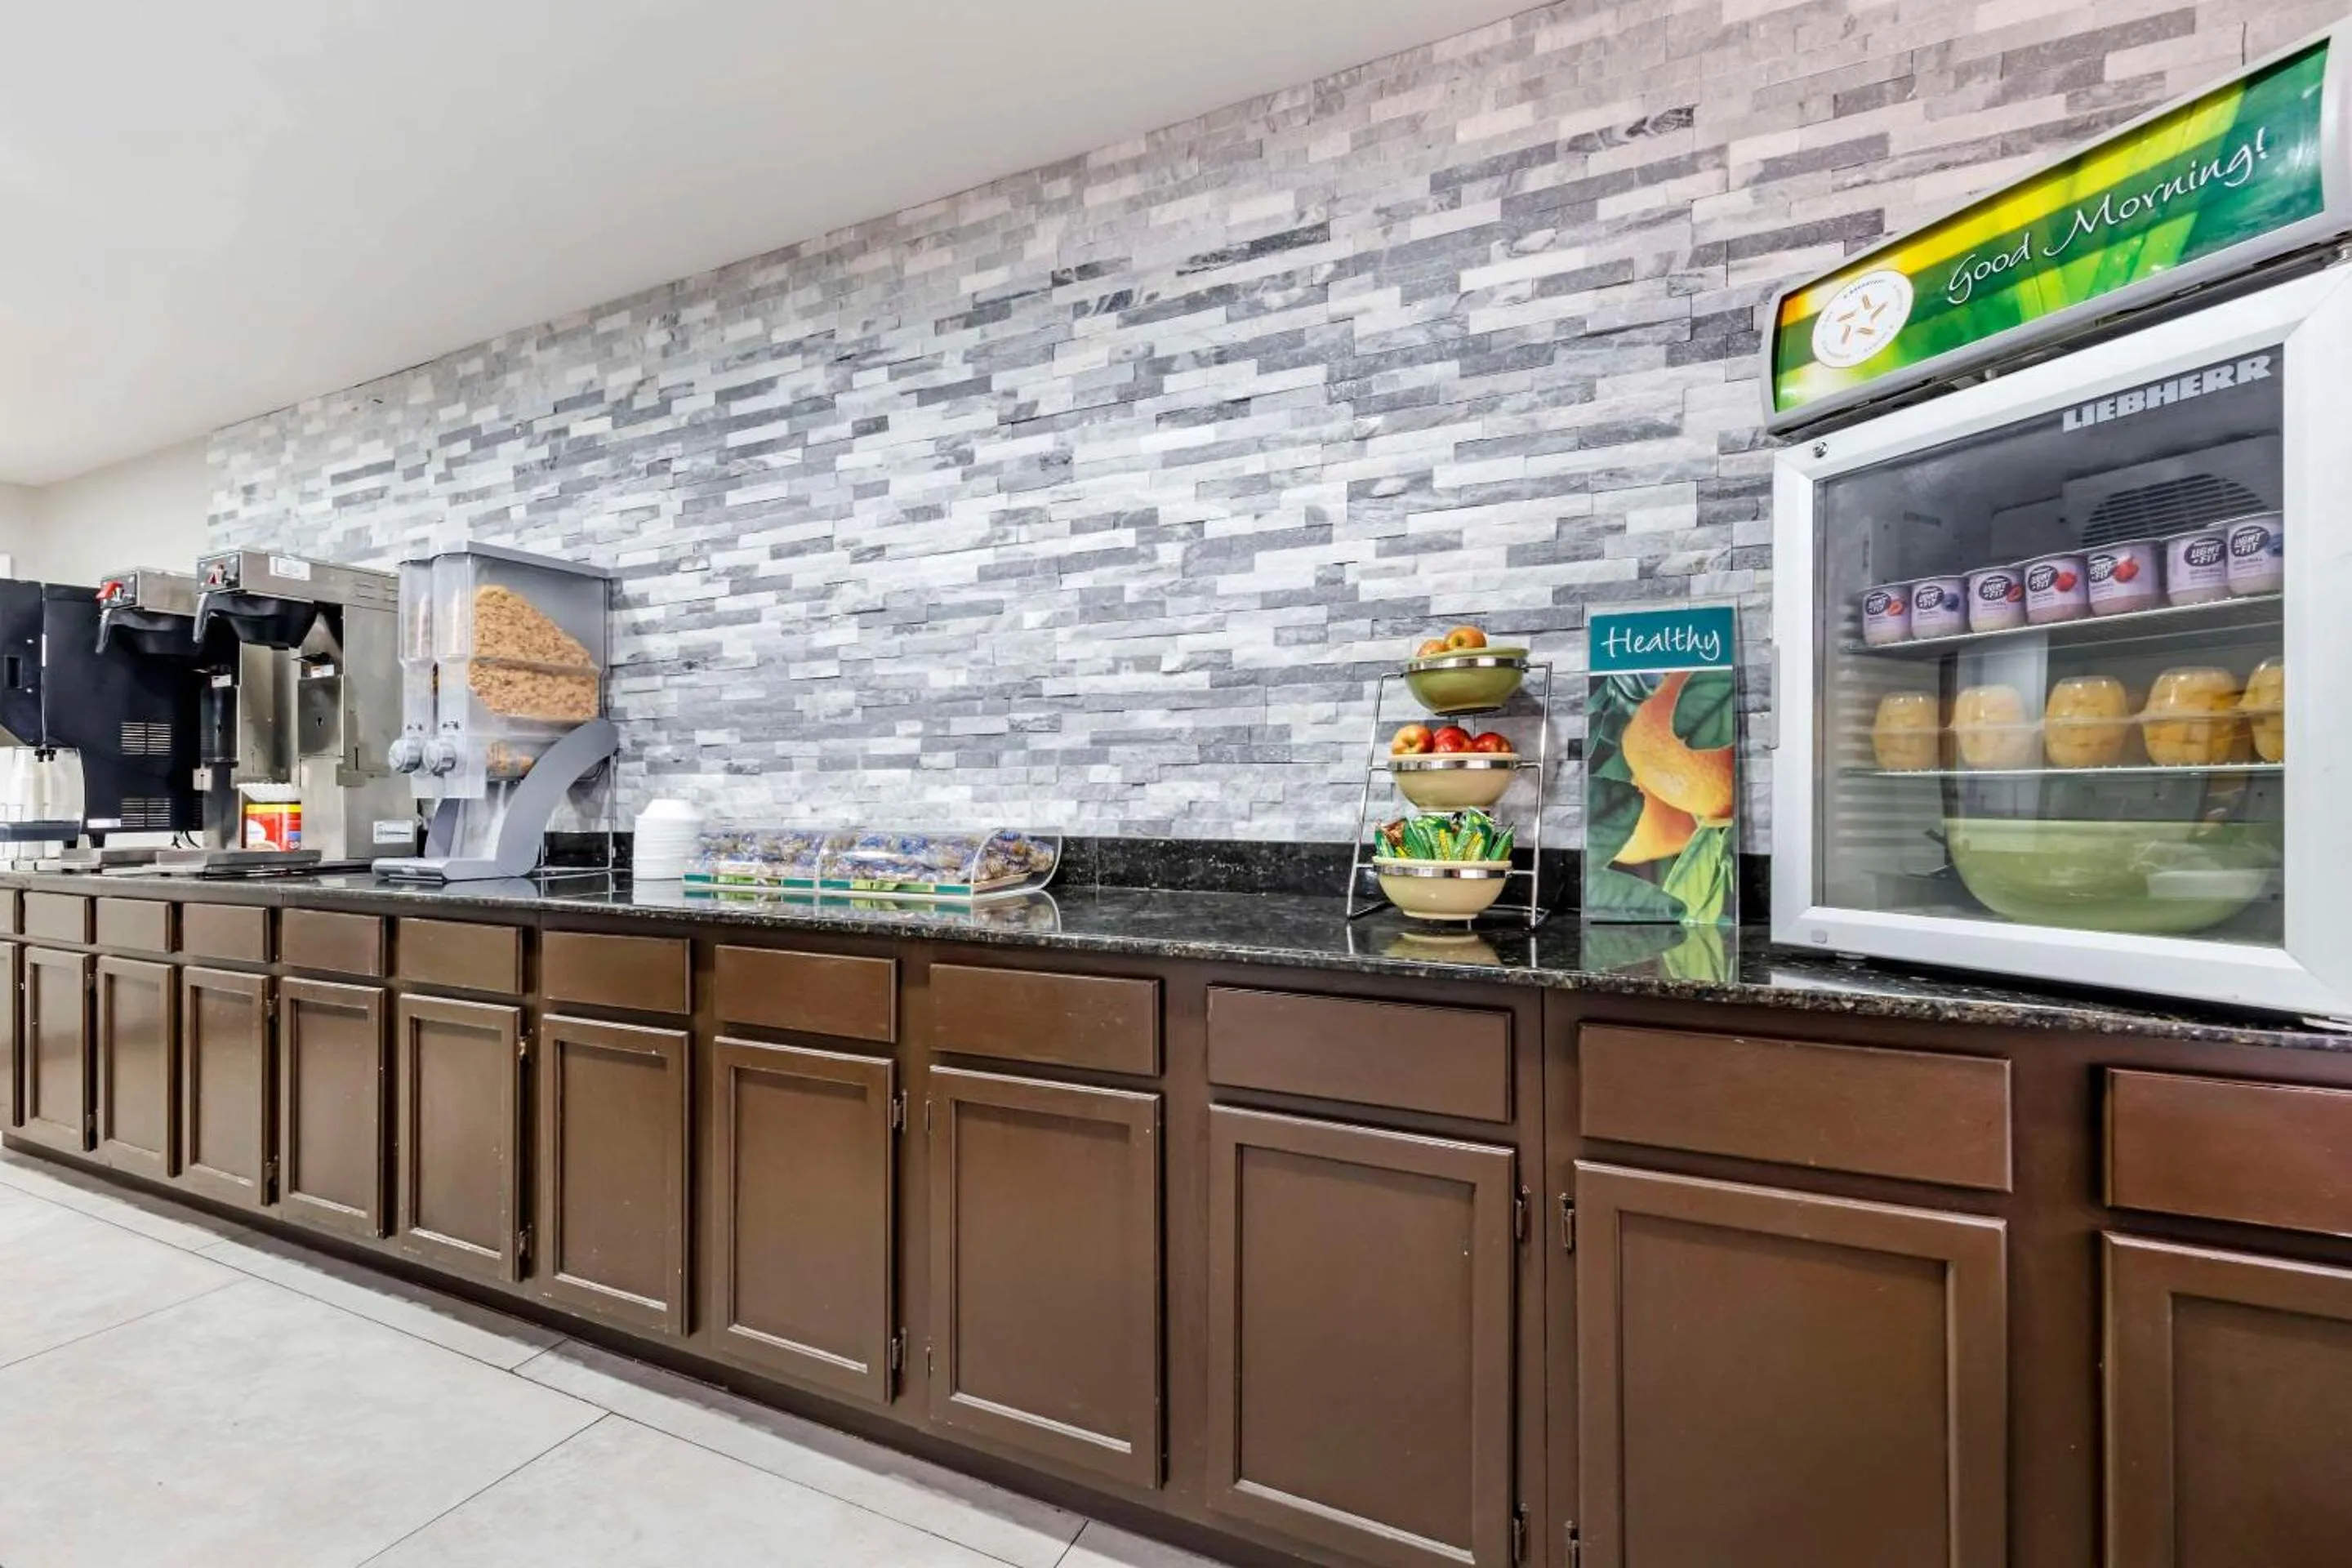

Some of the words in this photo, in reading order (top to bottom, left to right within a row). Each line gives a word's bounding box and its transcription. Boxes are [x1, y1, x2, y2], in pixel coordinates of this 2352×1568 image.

[1947, 230, 2032, 305] Good
[2042, 126, 2270, 258] Morning!
[2062, 355, 2272, 434] LIEBHERR
[1601, 624, 1721, 661] Healthy
